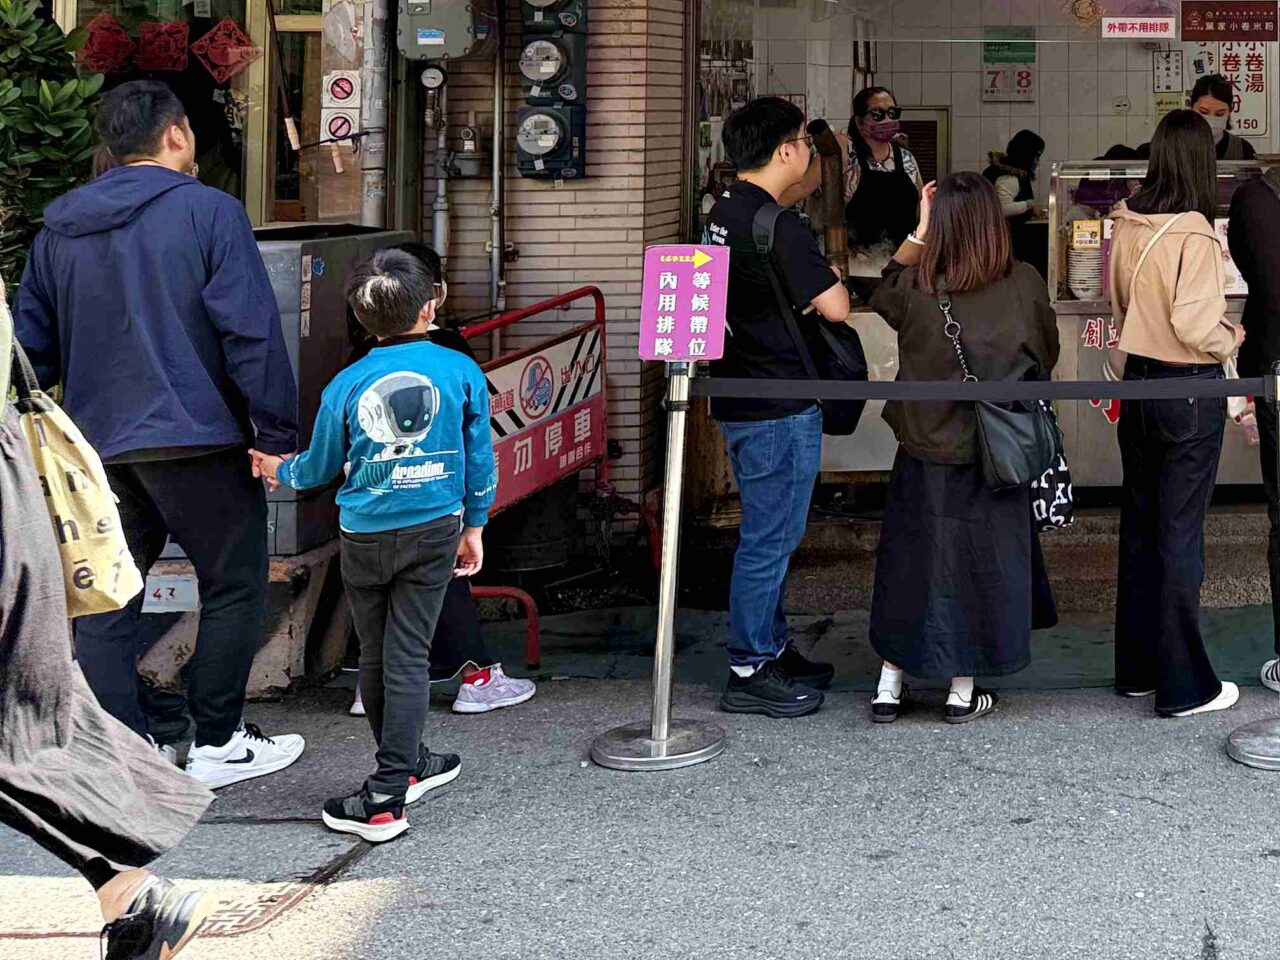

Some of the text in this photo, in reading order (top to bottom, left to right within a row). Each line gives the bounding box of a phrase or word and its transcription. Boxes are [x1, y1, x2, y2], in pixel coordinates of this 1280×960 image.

[1107, 22, 1170, 33] 外帶不用排隊
[1017, 71, 1032, 88] 8
[1236, 119, 1258, 129] 150
[654, 271, 678, 356] 內用排隊
[688, 271, 711, 356] 等候帶位
[560, 353, 595, 386] 出入口
